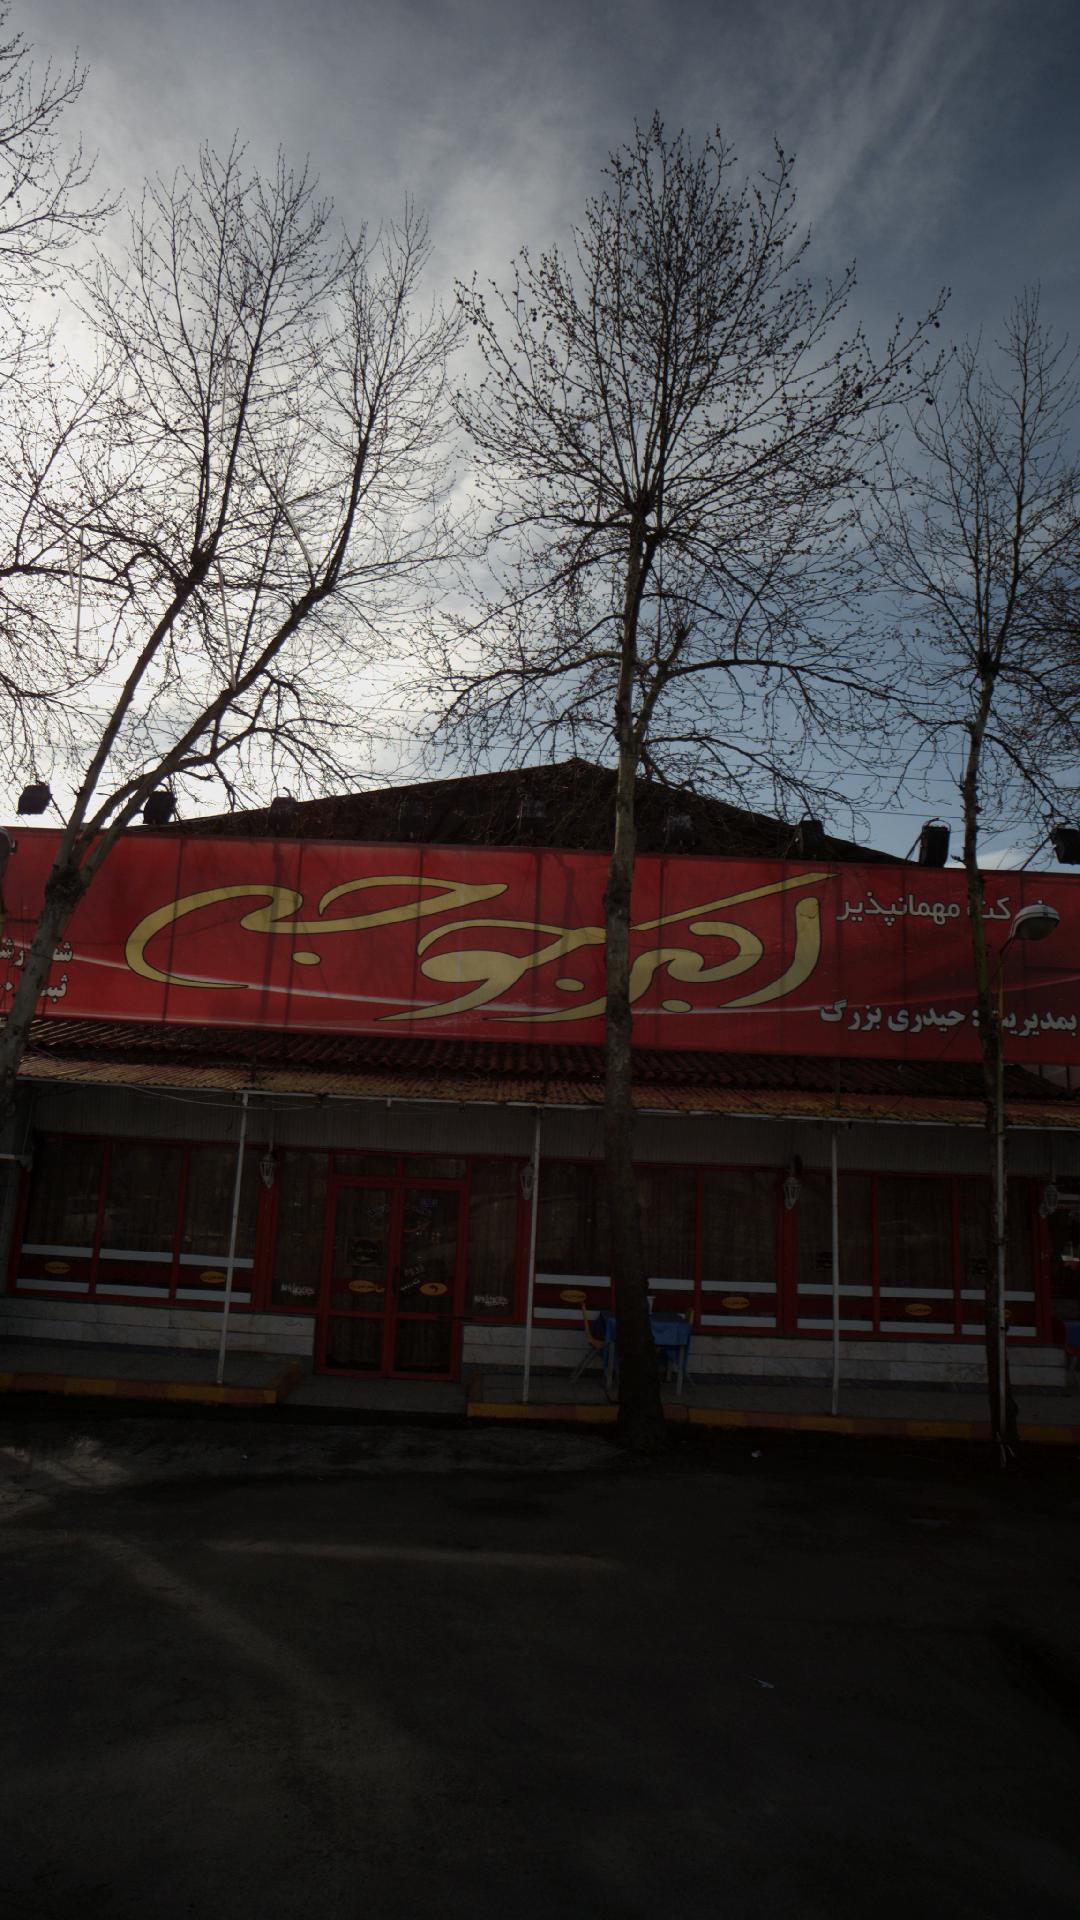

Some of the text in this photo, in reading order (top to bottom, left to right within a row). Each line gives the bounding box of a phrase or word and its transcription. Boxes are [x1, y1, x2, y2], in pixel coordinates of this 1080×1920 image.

[836, 891, 960, 926] مهمانپذیر
[820, 998, 883, 1031] بزرگ
[887, 1007, 967, 1033] حیدری
